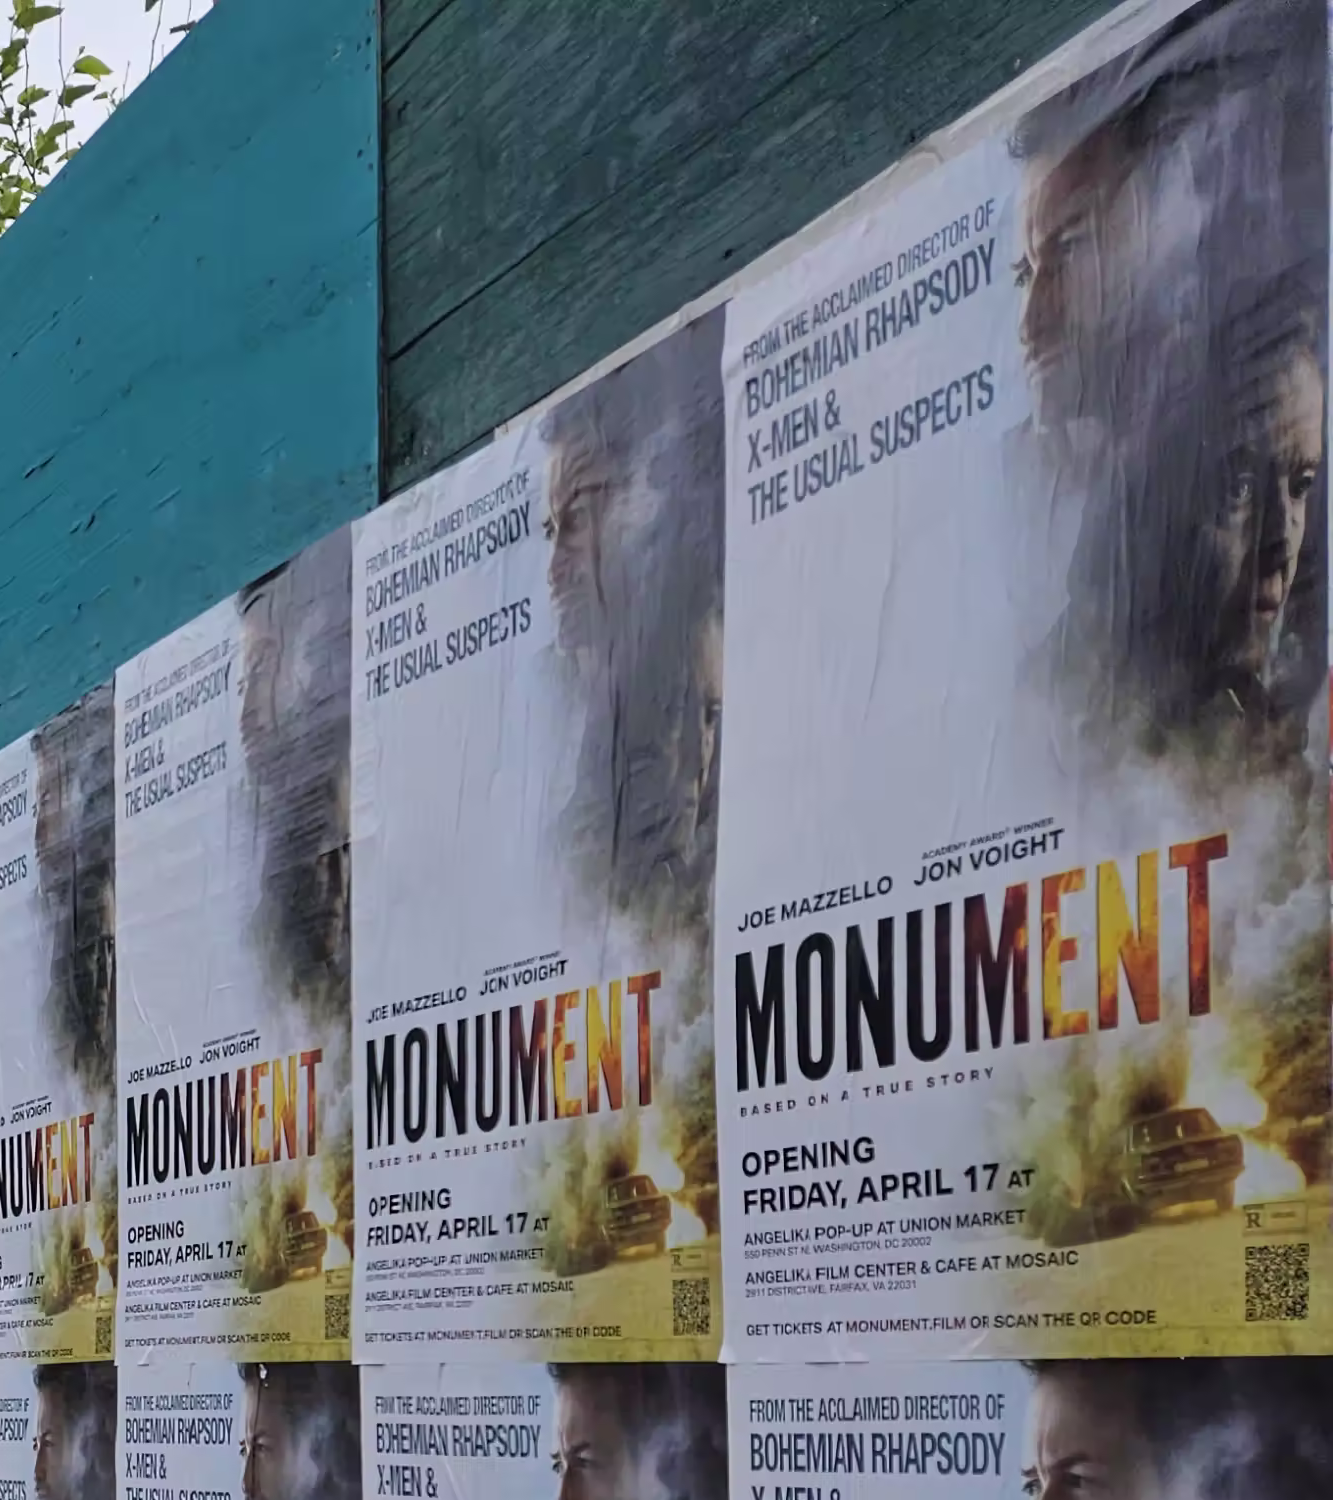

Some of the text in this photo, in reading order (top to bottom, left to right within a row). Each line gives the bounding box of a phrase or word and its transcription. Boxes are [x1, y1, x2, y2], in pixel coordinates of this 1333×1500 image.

[743, 198, 996, 369] FROM THE ACCLAIMED DIRECTOR OF
[745, 238, 997, 418] BOHEMIAN RHAPSODY
[747, 389, 841, 473] X-MEN &
[747, 365, 995, 524] THE USUAL SUSPECTS
[365, 501, 531, 616] BOHEMIAN RHAPSODY
[914, 829, 1065, 887] JON VOIGHT
[738, 876, 893, 932] JOE MAZZELLO
[735, 833, 1228, 1093] MONUMENT
[366, 971, 662, 1150] MONUMENT
[126, 1048, 323, 1188] MONUMENT
[742, 1137, 876, 1177] OPENING
[369, 1188, 452, 1218] OPENING
[743, 1164, 1035, 1215] FRIDAY, APRIL 17 AT
[127, 1241, 233, 1269] FRIDAY, APRIL 17
[128, 1221, 184, 1244] OPENING
[366, 1213, 529, 1247] FRIDAY, APRIL 17
[126, 1418, 233, 1445] BOHEMIAN RHAPSODY
[750, 1393, 1005, 1422] FROM THE ACCLAIMED DIRECTOR OF
[376, 1423, 541, 1458] BOHEMIAN RHAPSODY
[750, 1432, 1005, 1476] BOHEMIAN RHAPSODY
